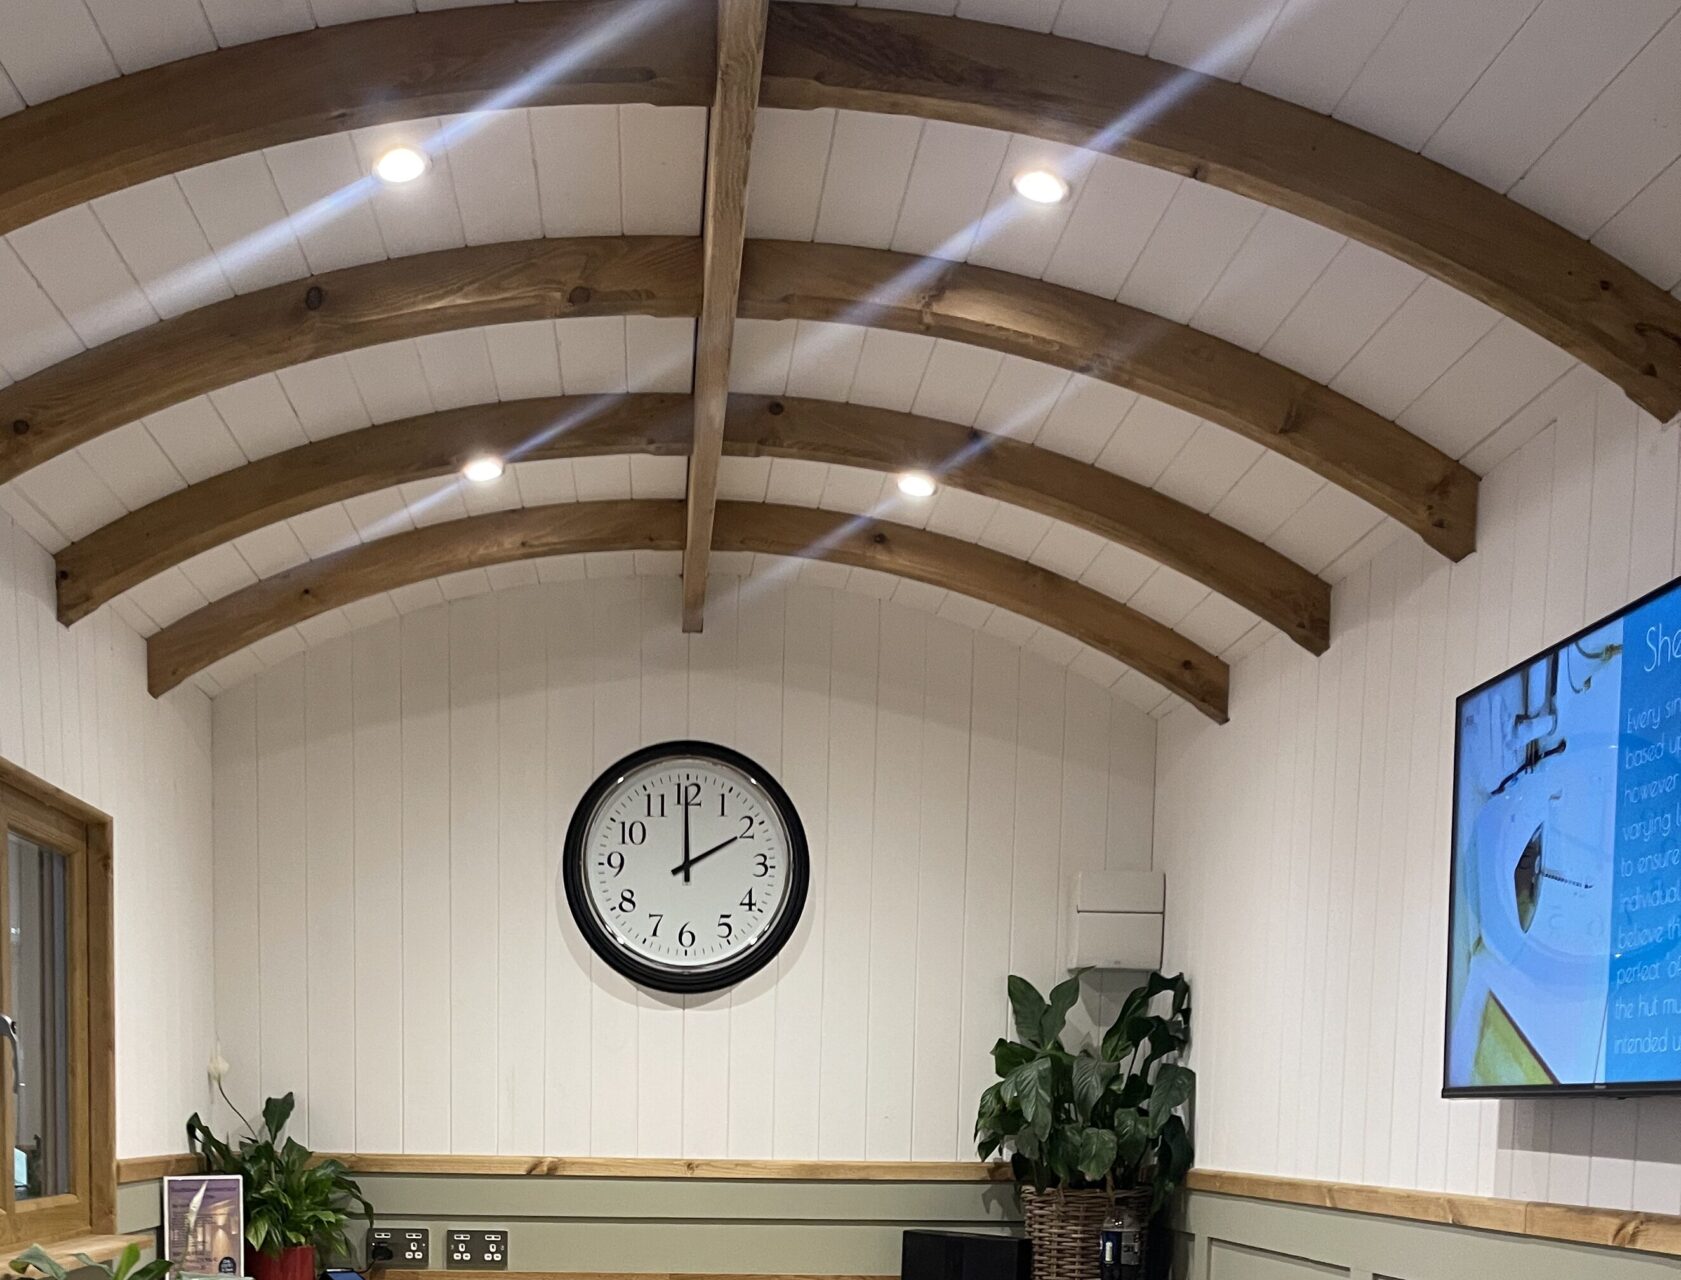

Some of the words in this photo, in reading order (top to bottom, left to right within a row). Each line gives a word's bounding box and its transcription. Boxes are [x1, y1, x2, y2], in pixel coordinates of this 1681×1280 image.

[1627, 705, 1660, 734] Every
[1625, 732, 1665, 769] based
[675, 783, 702, 807] 12
[1624, 773, 1680, 805] however
[646, 794, 667, 817] 11
[717, 794, 728, 817] 1
[619, 821, 646, 845] 10
[739, 816, 754, 839] 2
[1621, 813, 1671, 842] varying
[607, 851, 625, 877] 9
[752, 853, 768, 877] 3
[1621, 857, 1633, 877] to
[1637, 848, 1680, 874] ensure
[619, 889, 636, 912] 8
[739, 888, 756, 912] 4
[648, 914, 664, 937] 7
[678, 921, 696, 948] 6
[717, 914, 732, 938] 5
[1617, 922, 1664, 949] believe
[1617, 960, 1660, 990] perfect
[1615, 996, 1633, 1020] the
[1638, 993, 1658, 1016] hut
[1614, 1026, 1668, 1054] intended
